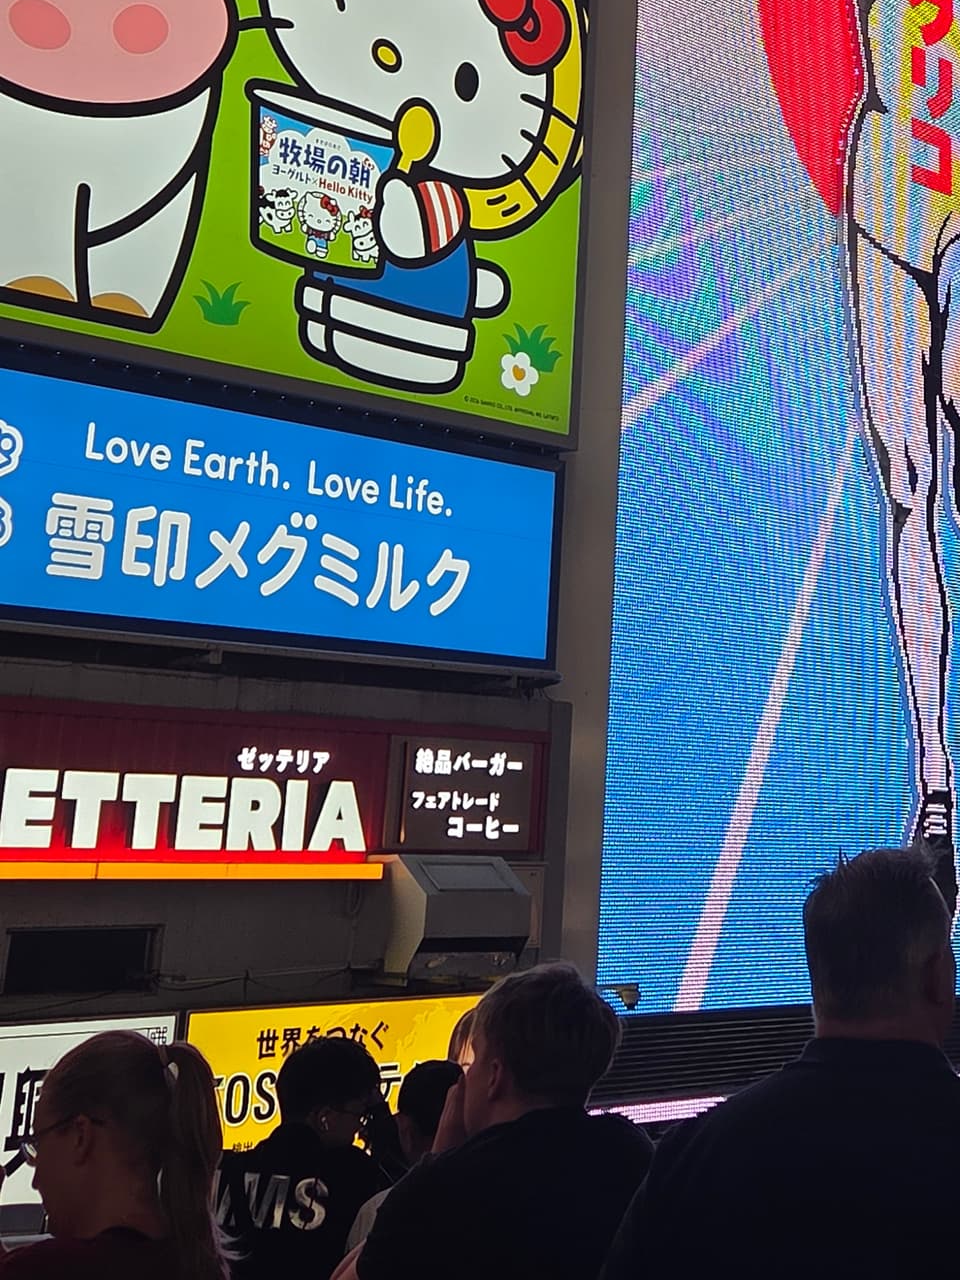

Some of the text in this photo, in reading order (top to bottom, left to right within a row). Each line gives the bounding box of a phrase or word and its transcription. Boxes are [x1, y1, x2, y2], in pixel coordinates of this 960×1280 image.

[279, 137, 370, 189] 牧場の朝
[319, 177, 346, 195] Hello
[348, 185, 374, 204] Kitty
[85, 423, 453, 518] Love Earth. Love Life.
[46, 492, 471, 617] 雪印メグミルク
[237, 746, 330, 774] ゼッテリア
[415, 748, 523, 777] 絶品バーガー
[2, 768, 368, 852] ETTERIA
[412, 791, 500, 811] フェアトレード
[447, 815, 520, 839] コーヒー
